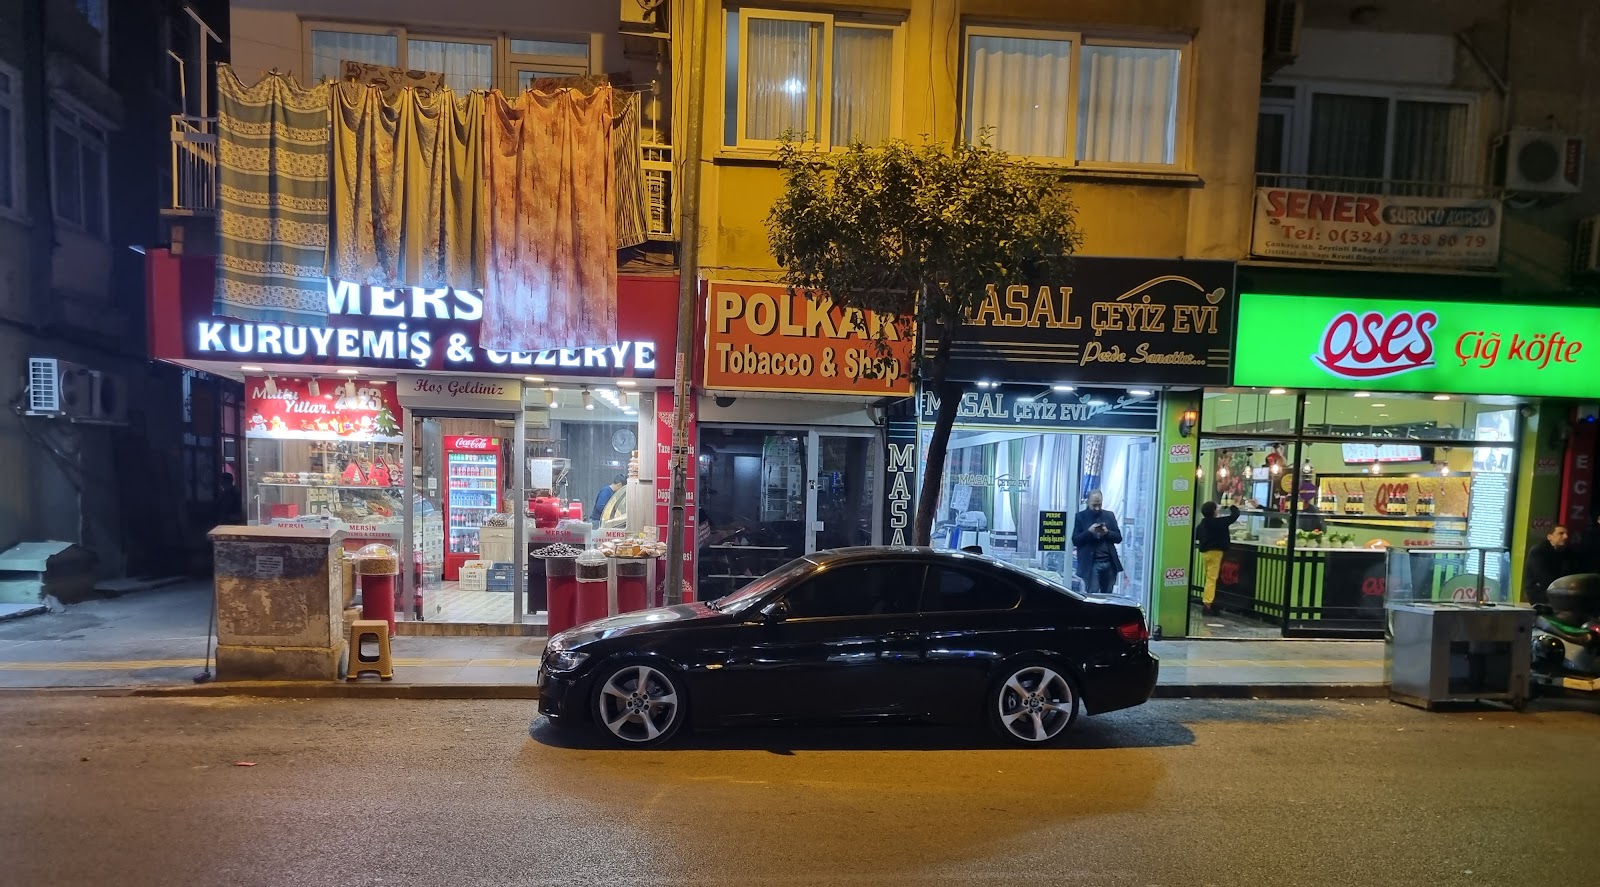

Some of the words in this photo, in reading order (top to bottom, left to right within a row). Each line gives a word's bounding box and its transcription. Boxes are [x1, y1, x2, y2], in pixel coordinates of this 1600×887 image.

[1266, 190, 1382, 227] ŞENER
[1281, 225, 1321, 242] Tel:
[1328, 228, 1392, 247] 0(324)
[1399, 232, 1432, 247] 238
[1464, 235, 1487, 249] 79
[938, 281, 1082, 331] ASAL
[1091, 295, 1167, 337] ÇEYİZ
[198, 321, 433, 370] KURUYEMİŞ
[446, 333, 475, 363] &
[1080, 341, 1127, 367] Perde
[1507, 332, 1584, 371] köfte
[716, 342, 813, 376] Tobacco
[820, 346, 838, 377] &
[844, 347, 900, 388] Shop
[414, 378, 443, 395] Hoş
[447, 380, 505, 397] Geldiniz
[925, 390, 1009, 419] MSAL
[1013, 397, 1057, 423] ÇEYİZ
